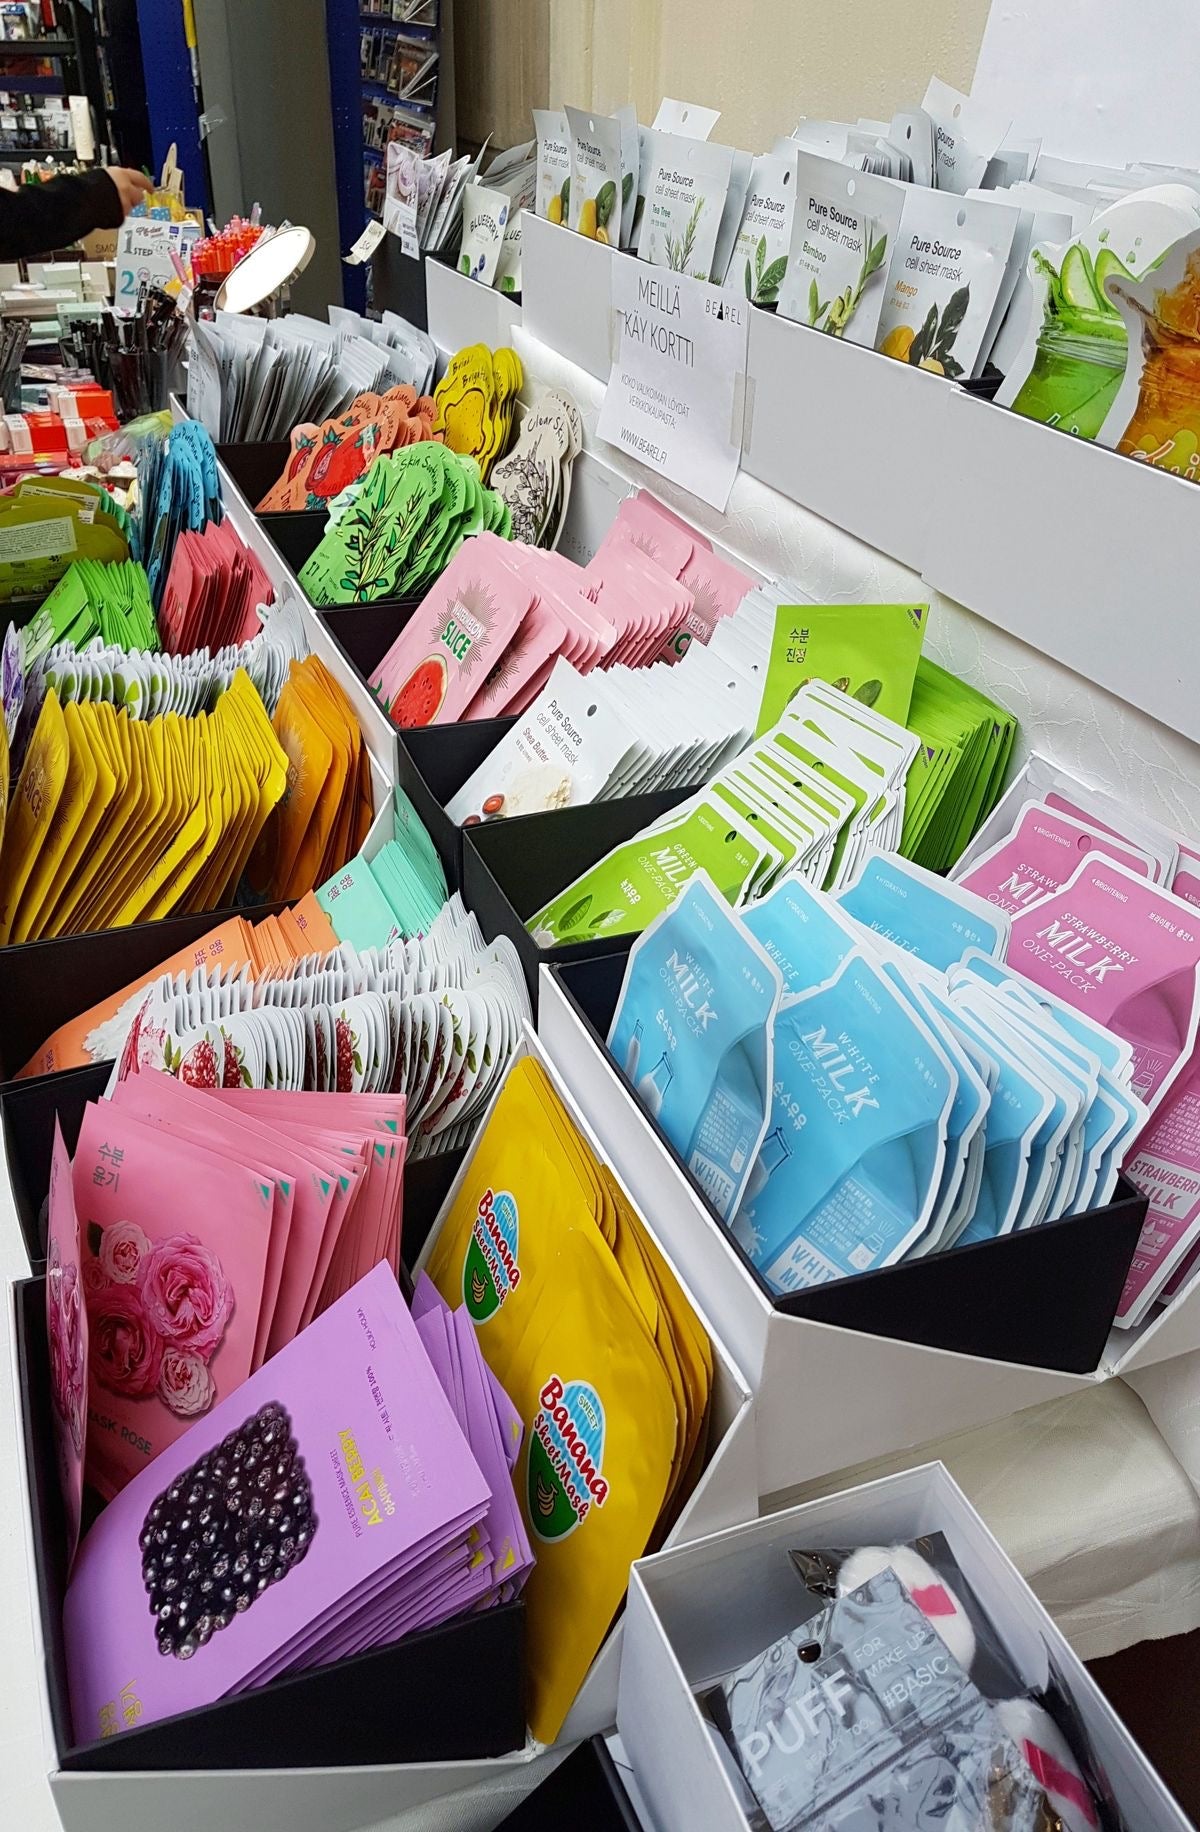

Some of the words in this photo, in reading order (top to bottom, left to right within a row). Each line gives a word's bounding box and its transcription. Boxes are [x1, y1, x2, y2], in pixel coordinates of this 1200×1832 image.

[655, 184, 664, 196] cell
[664, 187, 680, 200] sheet
[680, 191, 696, 204] mask
[658, 168, 671, 182] Pure
[672, 172, 694, 187] Source
[652, 204, 661, 214] Tea
[661, 206, 671, 217] Tree
[752, 194, 763, 207] Pure
[764, 197, 785, 213] Source
[808, 198, 828, 218] Pure
[830, 206, 858, 230] Source
[768, 218, 786, 230] mask
[806, 218, 820, 233] cell
[820, 223, 841, 242] sheet
[841, 232, 863, 254] mask
[802, 241, 827, 263] Bamboo
[910, 235, 929, 254] Pure
[930, 240, 962, 260] Source
[905, 256, 919, 271] cell
[919, 260, 941, 276] sheet
[941, 265, 963, 281] mask
[638, 276, 681, 318] MEILLÄ
[896, 280, 918, 298] Mango
[705, 299, 742, 326] BEAREL
[624, 310, 648, 343] KÄY
[650, 322, 694, 368] KORTTI
[441, 620, 472, 661] SLICE
[789, 628, 810, 644] 수분
[537, 713, 549, 727] cell
[545, 724, 563, 747] sheet
[560, 743, 579, 766] mask
[548, 700, 564, 721] Pure
[561, 716, 583, 746] Source
[523, 727, 535, 747] Shea
[532, 741, 549, 763] Butter
[1038, 826, 1071, 848] BRIGHTENING
[638, 856, 676, 900] ONE-PACK
[1094, 879, 1128, 903] BRIGHTENING
[1023, 939, 1097, 993] ONE-PACK
[1036, 920, 1125, 984] MILK
[659, 967, 704, 1038] ONE-PACK
[666, 948, 719, 1031] MILK
[788, 1040, 851, 1125] ONE-PACK
[802, 1024, 880, 1118] MILK
[98, 1142, 125, 1167] 수분
[694, 1158, 731, 1200] WHITE
[1130, 1159, 1200, 1196] STRAWBERRY
[479, 1189, 520, 1291] Banana
[489, 1256, 507, 1305] Mask
[790, 1245, 836, 1283] WHIT
[578, 1395, 598, 1431] SWEET
[121, 1426, 153, 1455] ROSE
[338, 1427, 365, 1483] BERRY
[540, 1377, 608, 1505] Banana
[534, 1413, 560, 1464] Sheet
[556, 1462, 589, 1522] Mask
[355, 1480, 384, 1525] ACAI
[854, 1636, 886, 1662] FOR
[865, 1646, 907, 1679] MAKE
[907, 1631, 926, 1653] UP
[881, 1655, 950, 1710] #BASIC
[740, 1667, 852, 1778] PUFF
